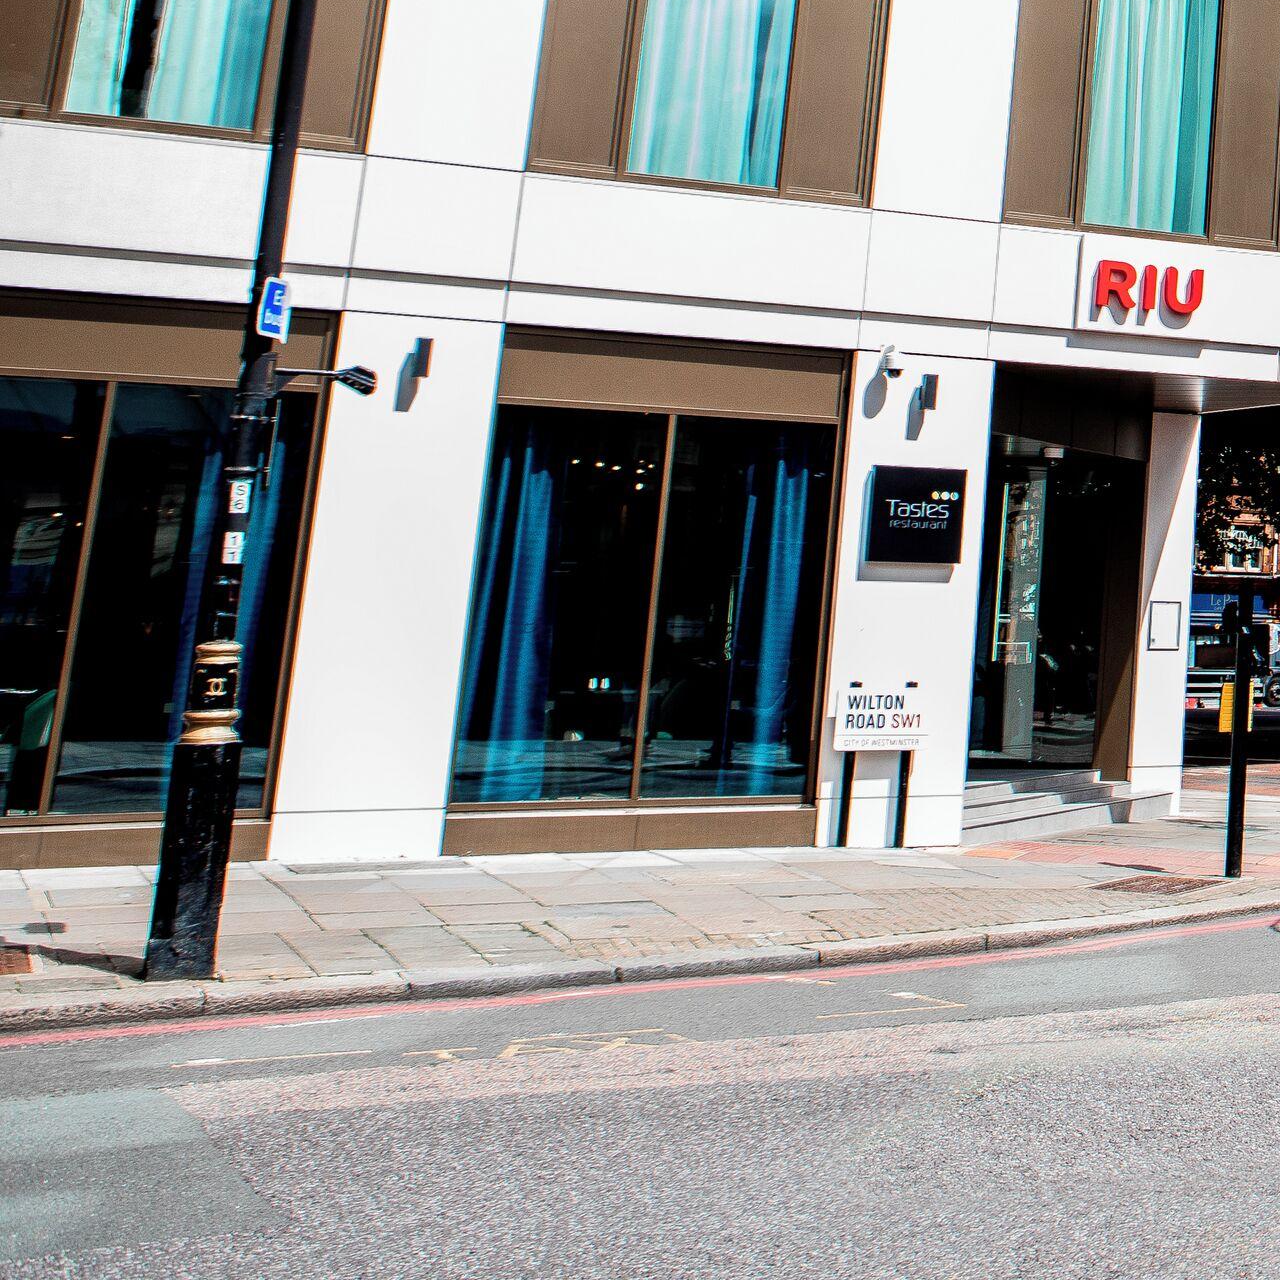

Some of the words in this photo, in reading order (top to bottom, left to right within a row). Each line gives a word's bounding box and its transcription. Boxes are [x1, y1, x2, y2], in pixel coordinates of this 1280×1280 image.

[1096, 260, 1205, 314] RIU
[885, 499, 950, 519] Tastes
[889, 519, 948, 530] restaurant
[847, 695, 905, 710] WILTON
[845, 713, 886, 729] ROAD
[891, 713, 921, 729] SW1
